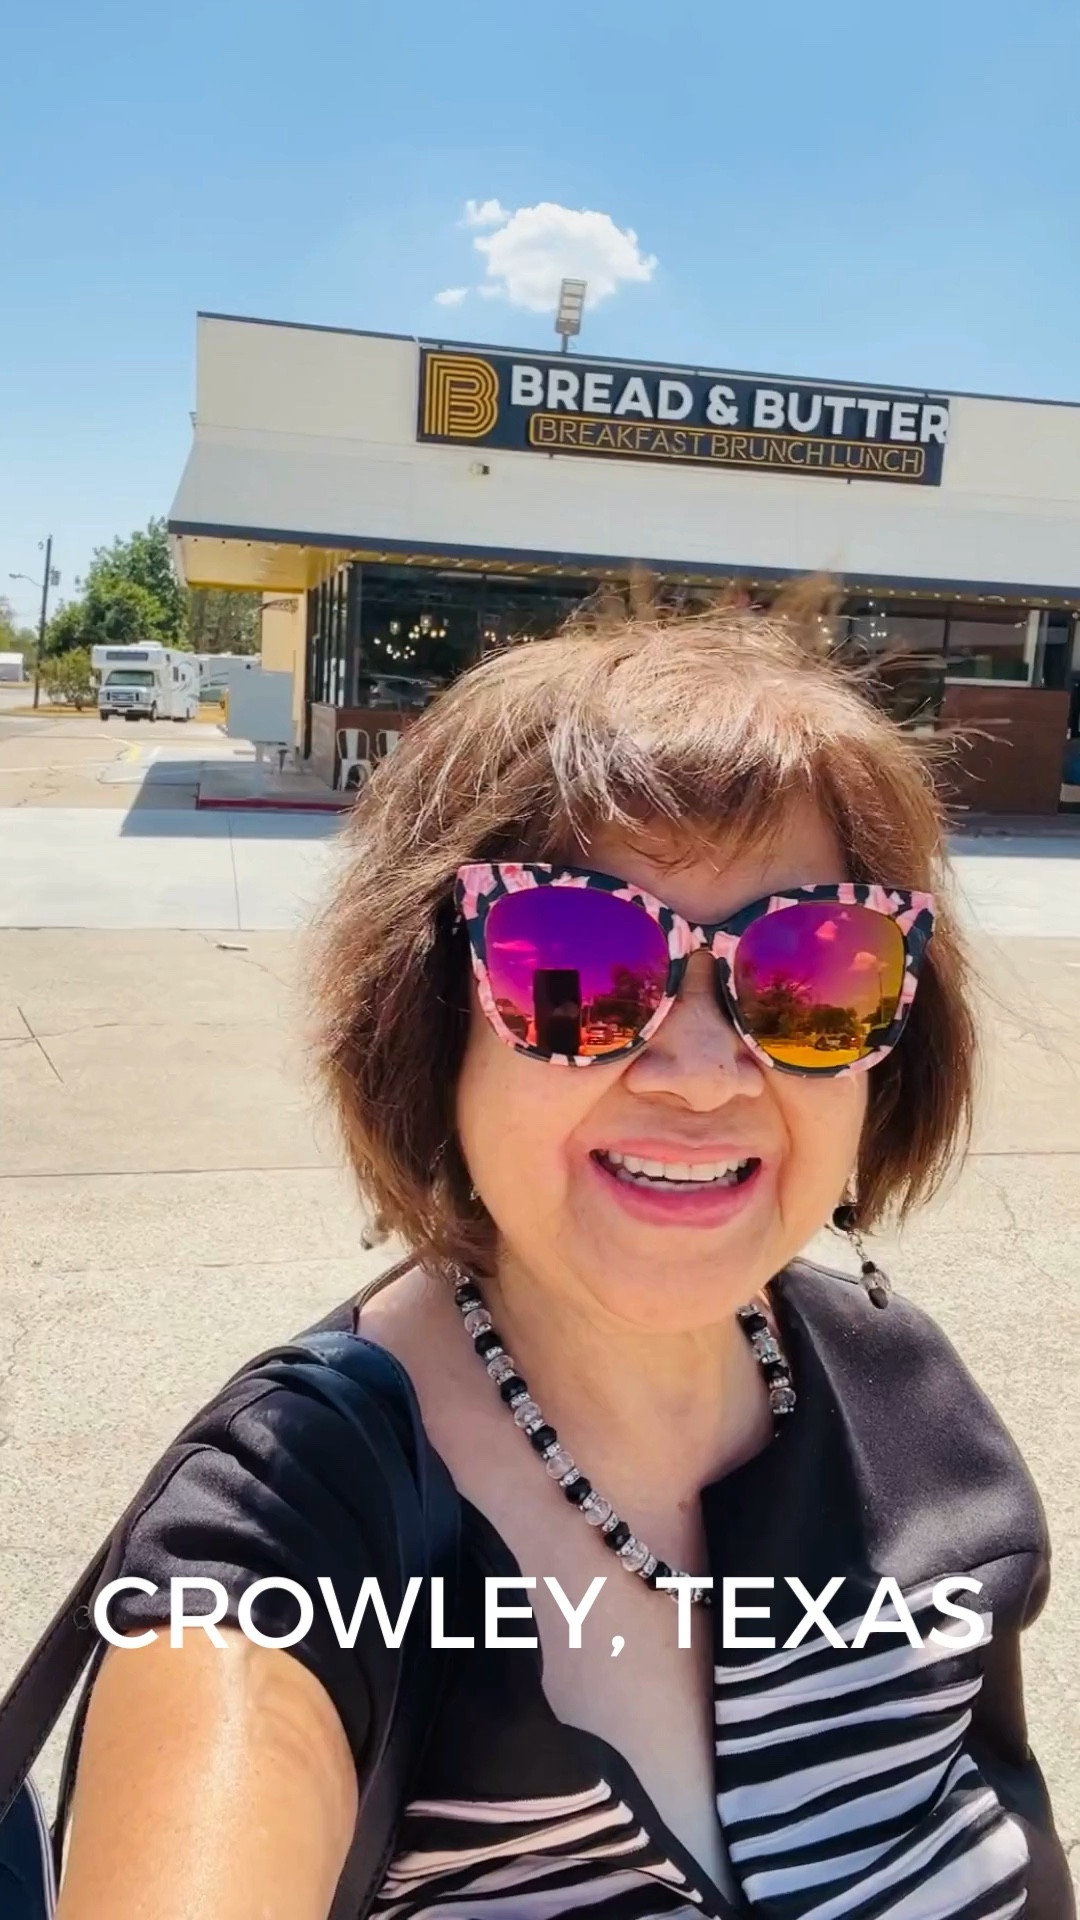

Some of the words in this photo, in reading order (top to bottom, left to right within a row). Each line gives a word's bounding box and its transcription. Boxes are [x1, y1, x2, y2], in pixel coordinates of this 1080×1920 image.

[424, 352, 499, 439] B
[510, 364, 693, 422] BREAD
[705, 384, 740, 427] &
[753, 389, 949, 444] BUTTER
[537, 418, 705, 456] BREAKFAST
[711, 436, 824, 467] BRUNCH
[830, 446, 921, 474] LUNCH
